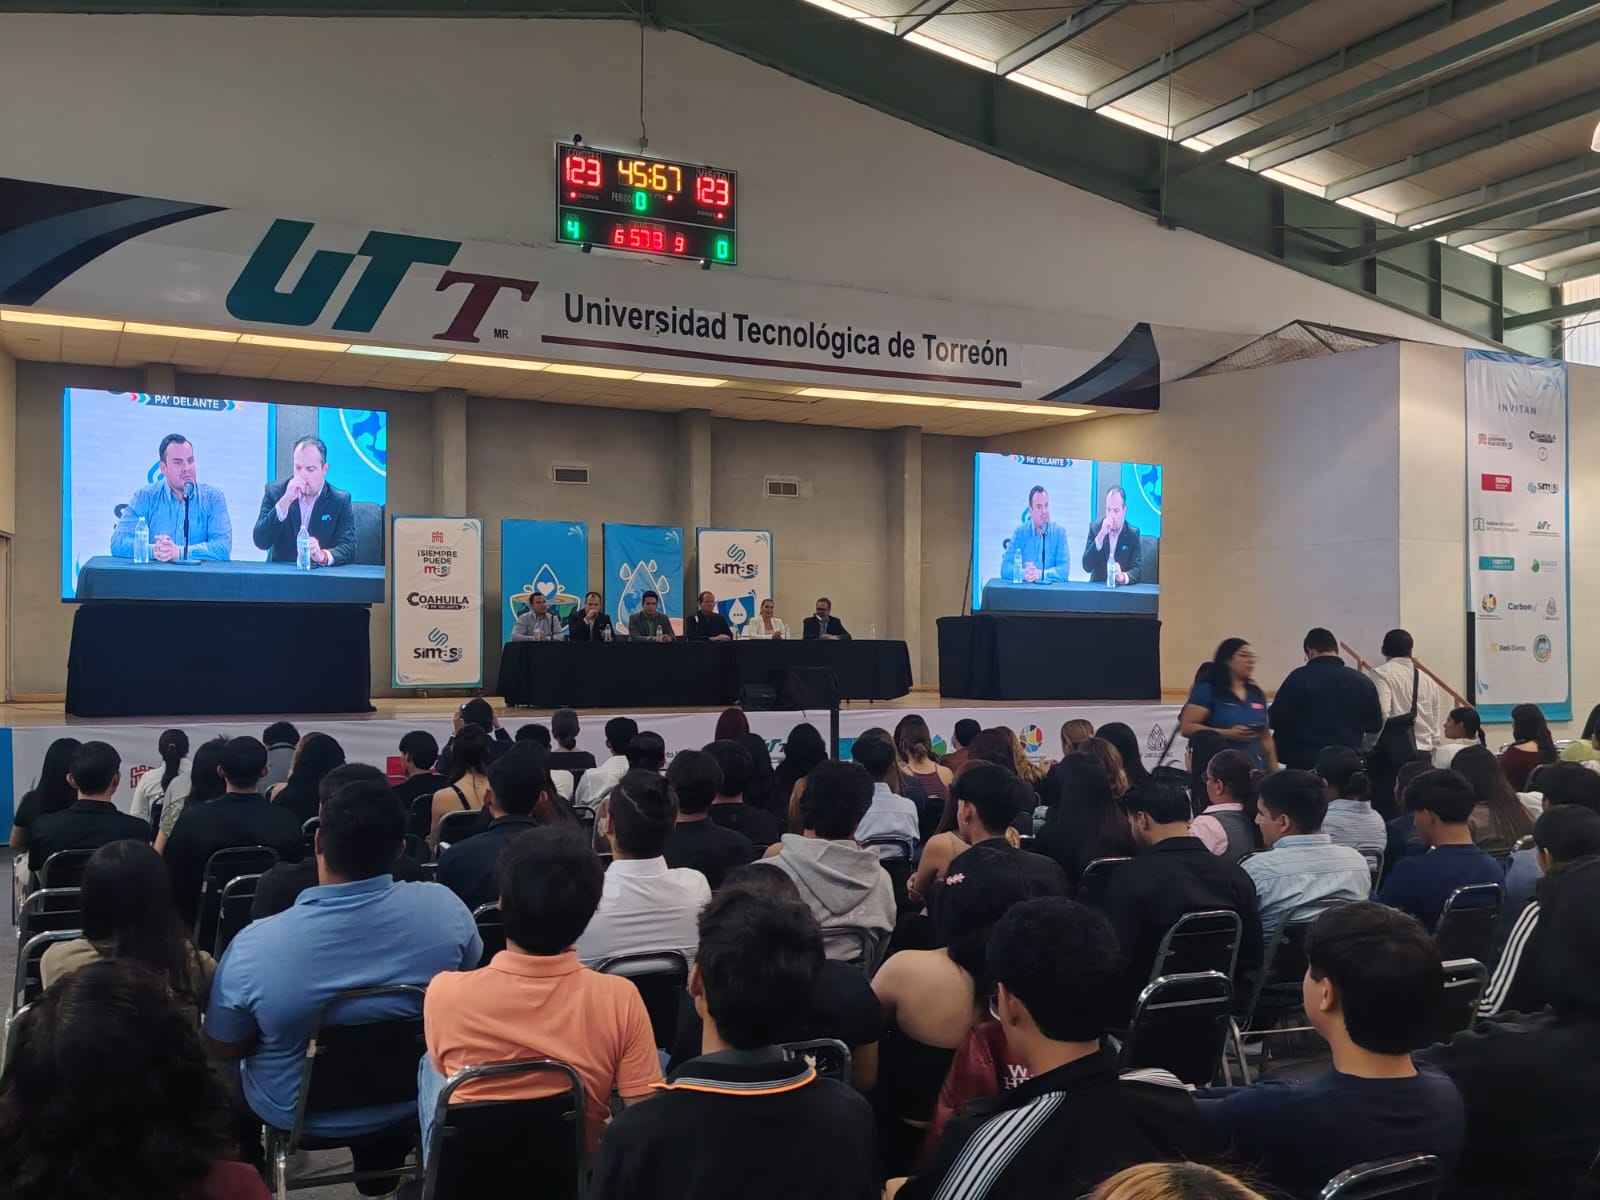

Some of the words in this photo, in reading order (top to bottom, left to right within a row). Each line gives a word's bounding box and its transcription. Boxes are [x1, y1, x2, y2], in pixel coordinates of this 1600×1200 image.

[566, 156, 601, 187] 123
[618, 159, 682, 192] 45:67
[696, 177, 729, 206] 123
[635, 191, 647, 211] 0
[567, 219, 580, 239] 4
[614, 229, 624, 244] 6
[674, 237, 685, 252] 9
[716, 239, 729, 259] 0
[493, 328, 509, 340] MR
[564, 293, 726, 341] Universidad
[733, 313, 880, 359] Tecnológica
[888, 330, 916, 359] de
[922, 333, 1008, 367] Torreón
[172, 396, 219, 409] DELANTE
[1498, 402, 1537, 415] INVITAN
[1037, 457, 1064, 467] DELANTE
[407, 591, 470, 607] COAHUILA
[1507, 602, 1532, 611] Carbon
